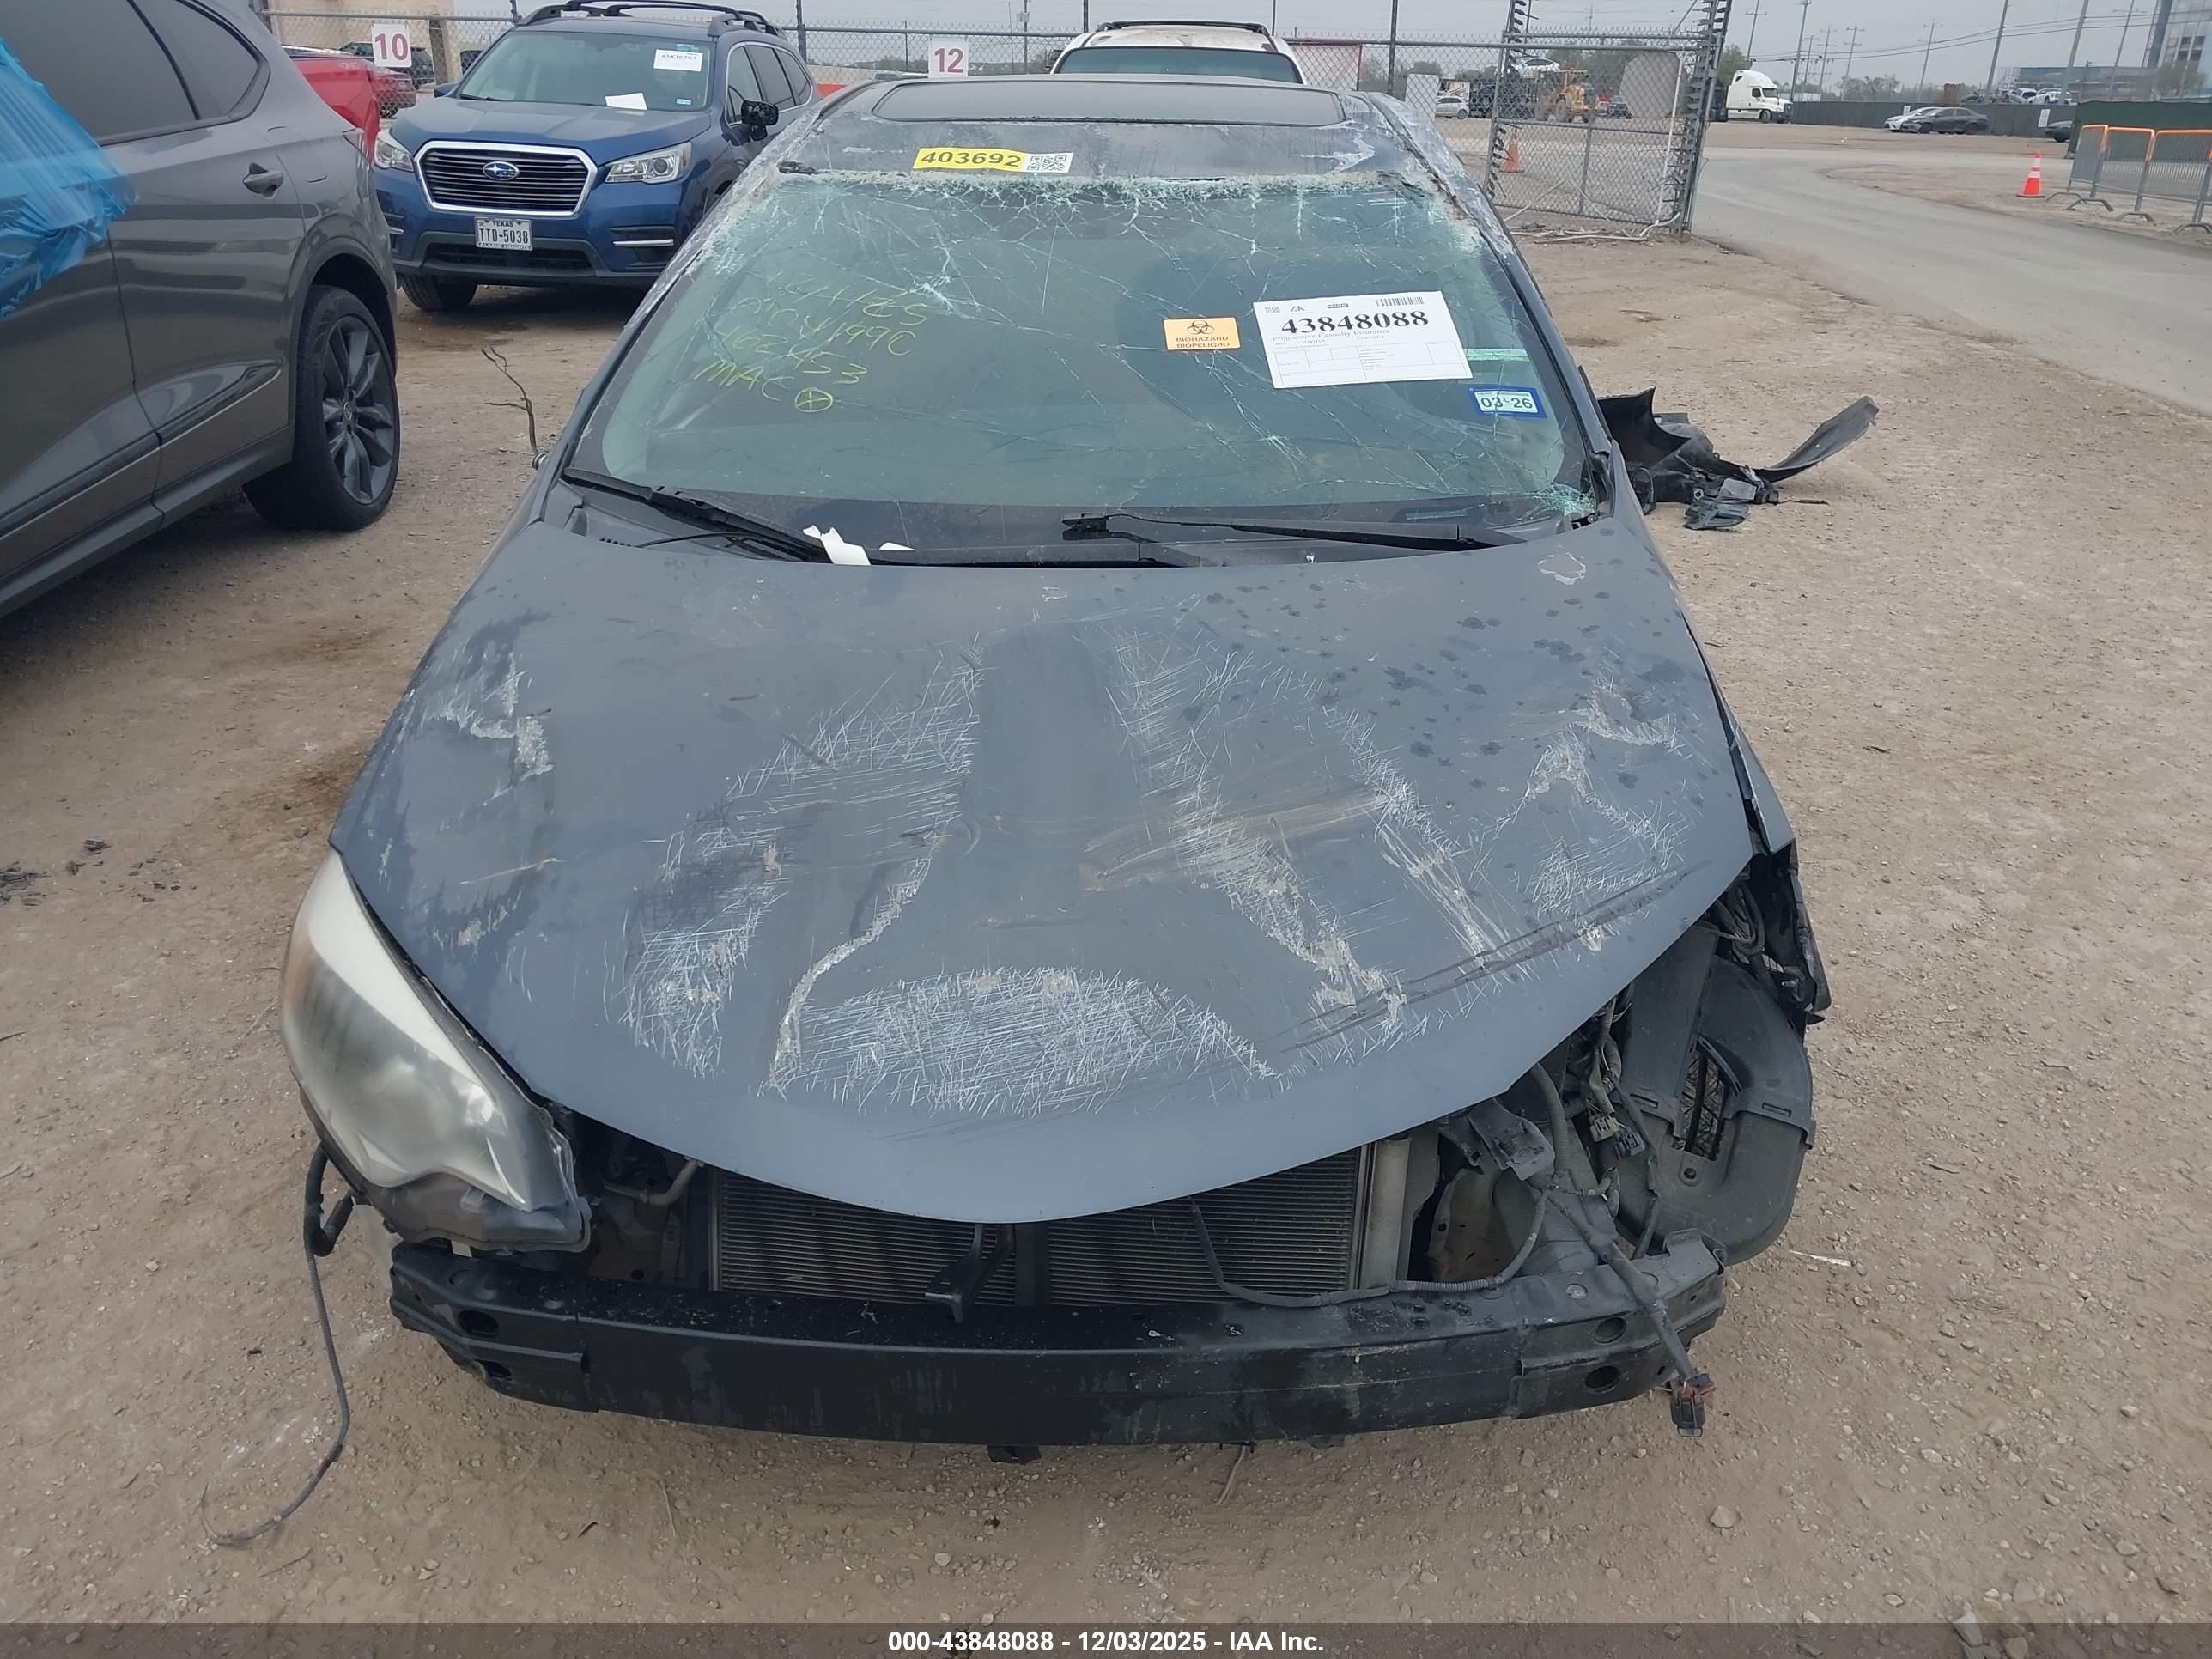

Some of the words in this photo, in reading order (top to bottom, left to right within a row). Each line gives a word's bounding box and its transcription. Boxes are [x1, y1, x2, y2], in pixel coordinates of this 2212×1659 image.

[374, 33, 409, 61] 10
[933, 48, 963, 73] 12
[920, 151, 1022, 167] 403692
[1281, 310, 1429, 334] 43848088
